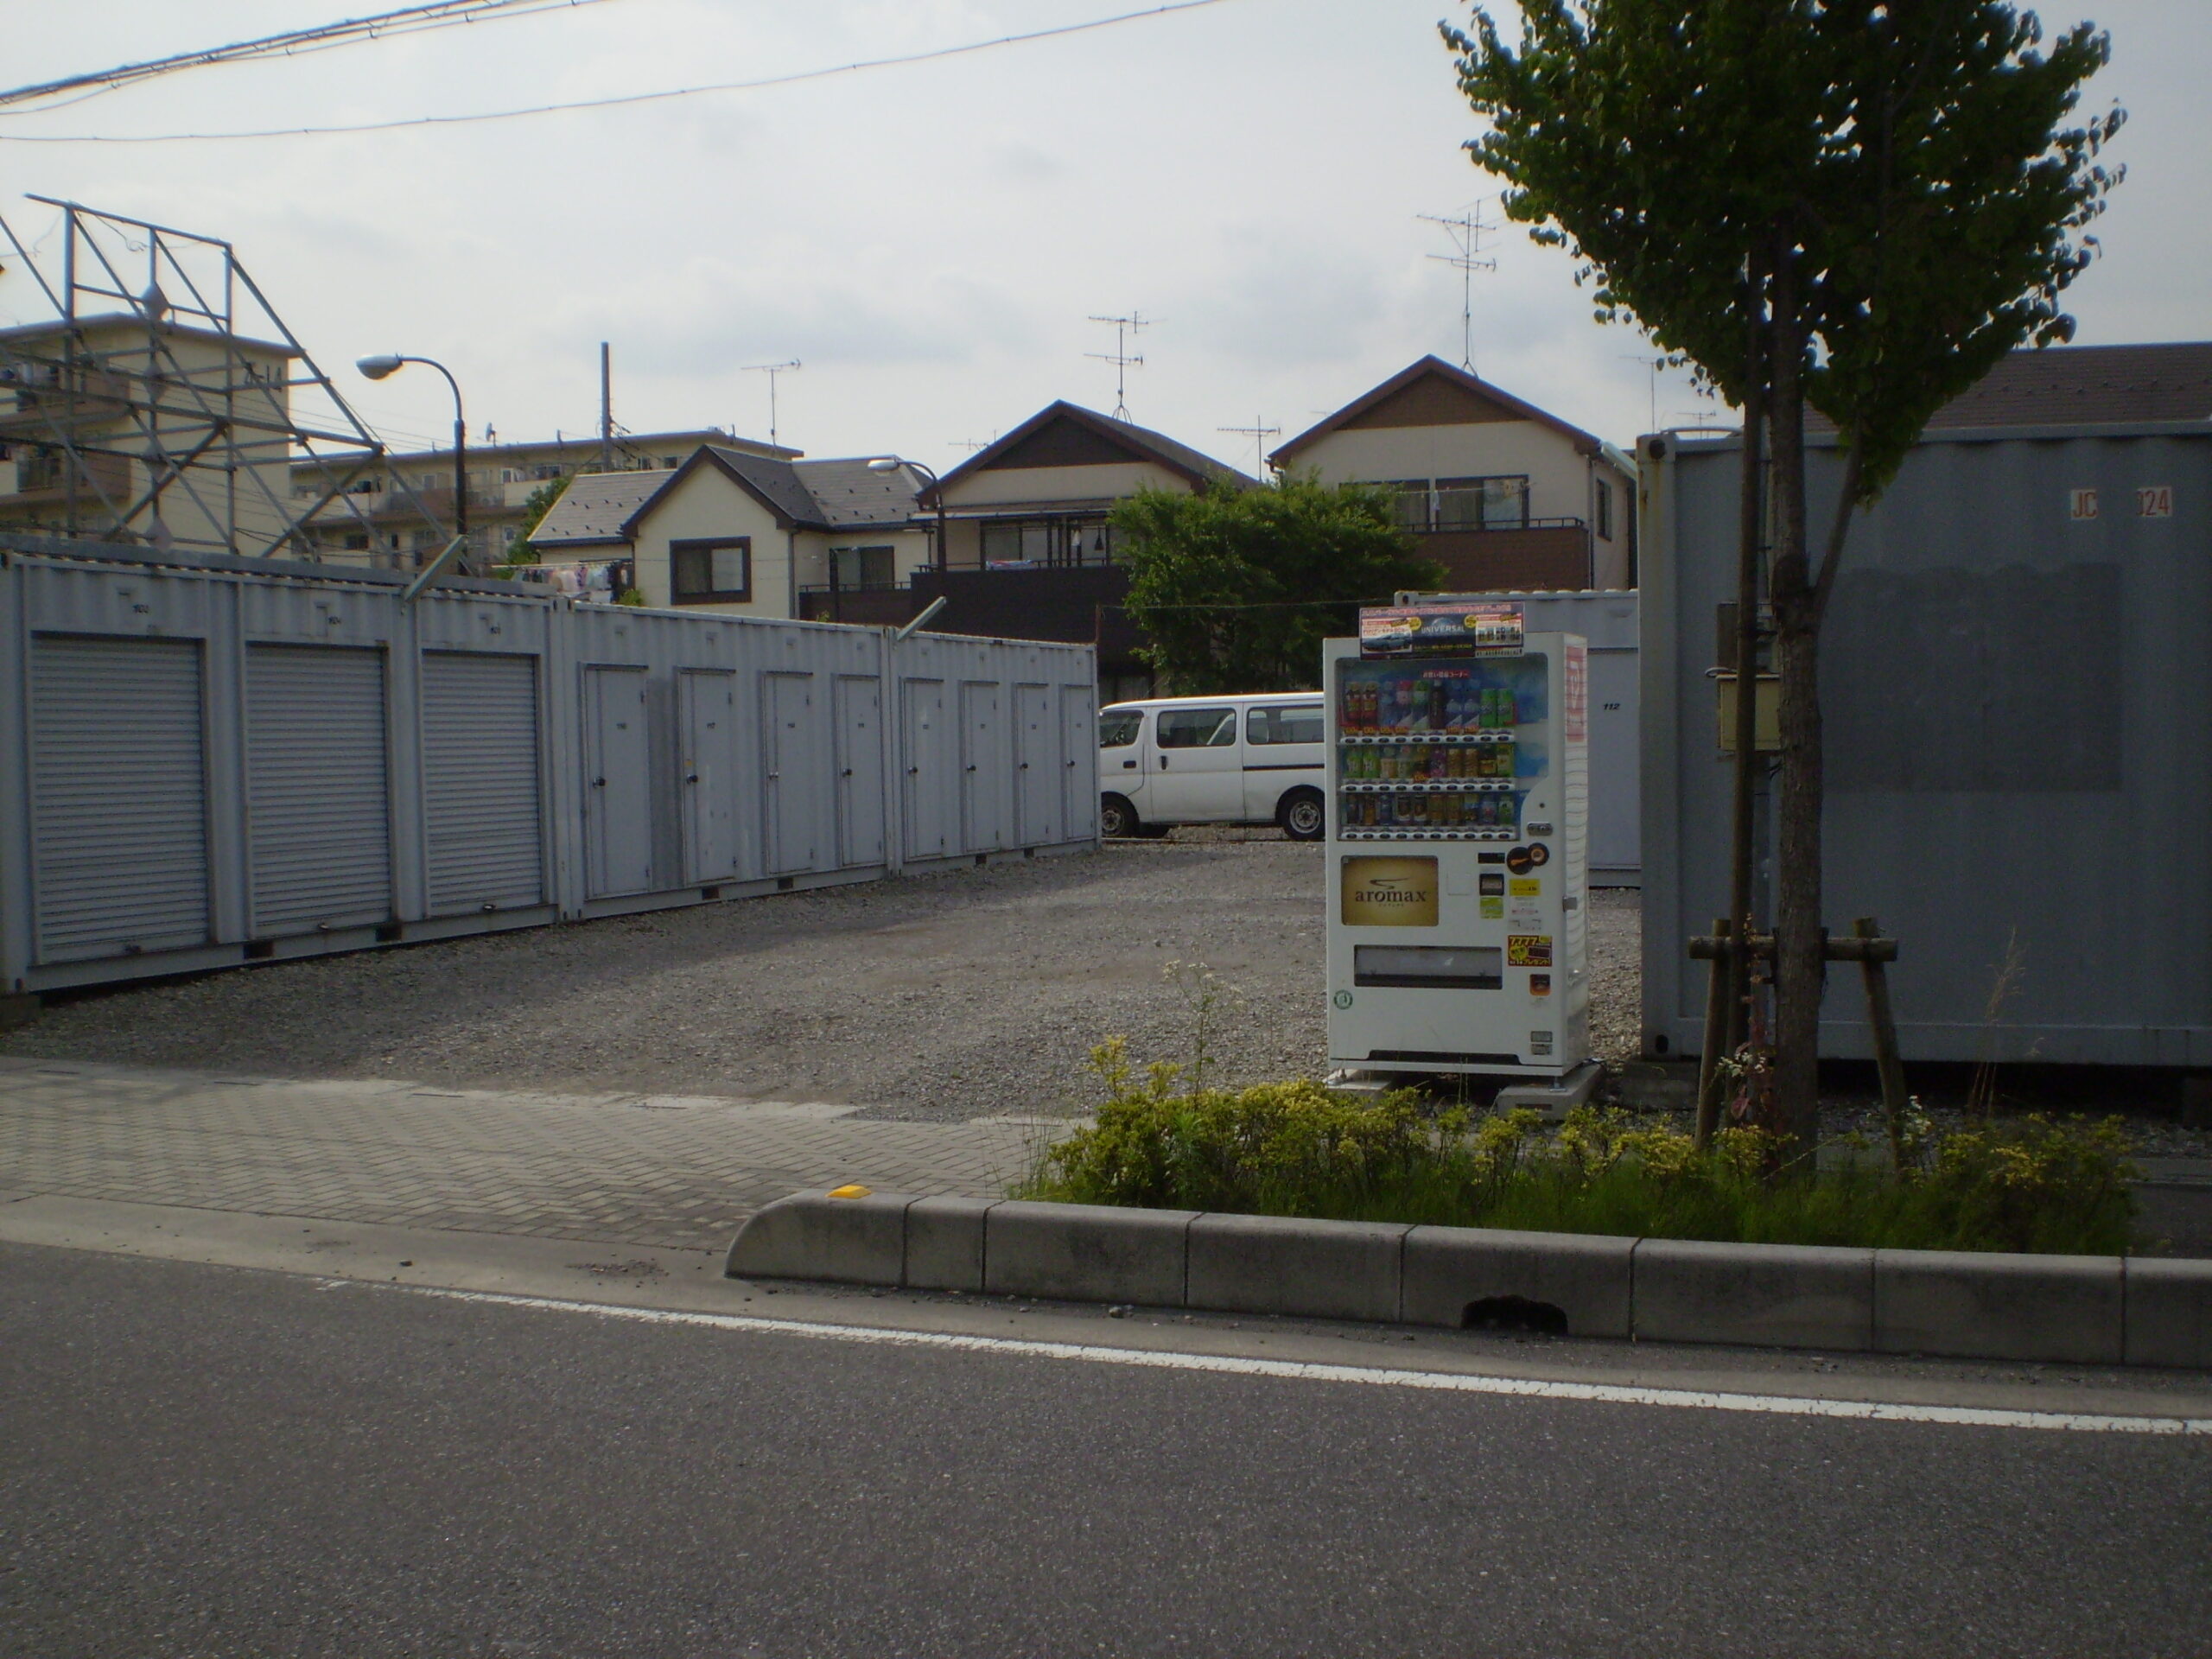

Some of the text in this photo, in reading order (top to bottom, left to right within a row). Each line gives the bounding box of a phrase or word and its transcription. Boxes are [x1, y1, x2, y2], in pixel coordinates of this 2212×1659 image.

[2073, 492, 2097, 518] JC
[1421, 625, 1465, 634] UNIVERSAL
[1355, 890, 1427, 902] aromax
[1509, 937, 1538, 946] 7777
